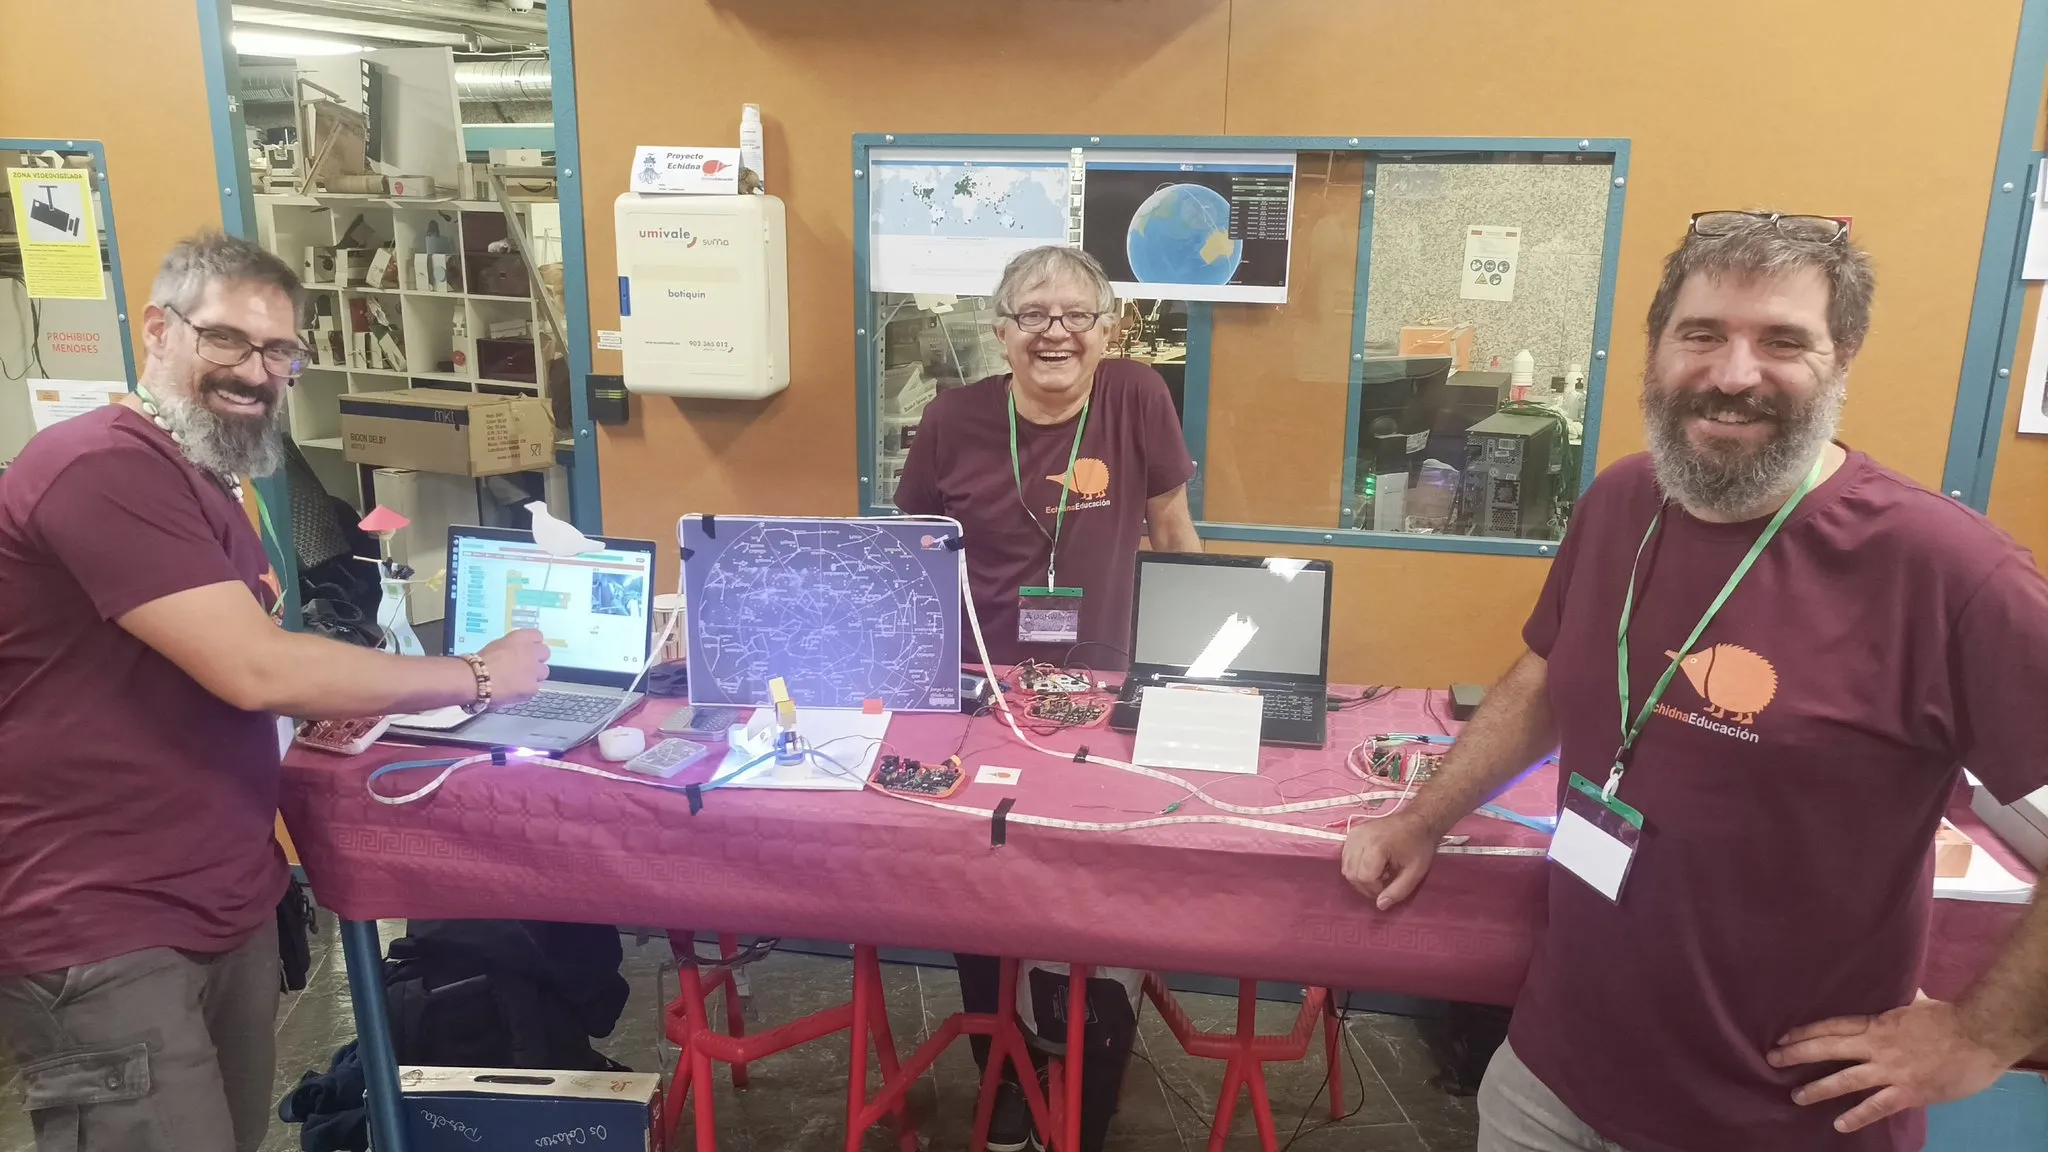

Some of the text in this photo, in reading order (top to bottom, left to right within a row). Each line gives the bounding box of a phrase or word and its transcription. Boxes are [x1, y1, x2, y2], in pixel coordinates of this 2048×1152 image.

[666, 151, 704, 162] Proyecto
[666, 162, 701, 170] Echidna
[13, 171, 83, 181] ZONA VIDEOVIGILADA
[639, 227, 691, 240] umivale
[702, 238, 729, 247] suma
[47, 332, 100, 344] PROHIBIDO
[52, 344, 98, 355] MENORES
[1652, 703, 1760, 743] chidnaEducación
[590, 1125, 607, 1140] Os
